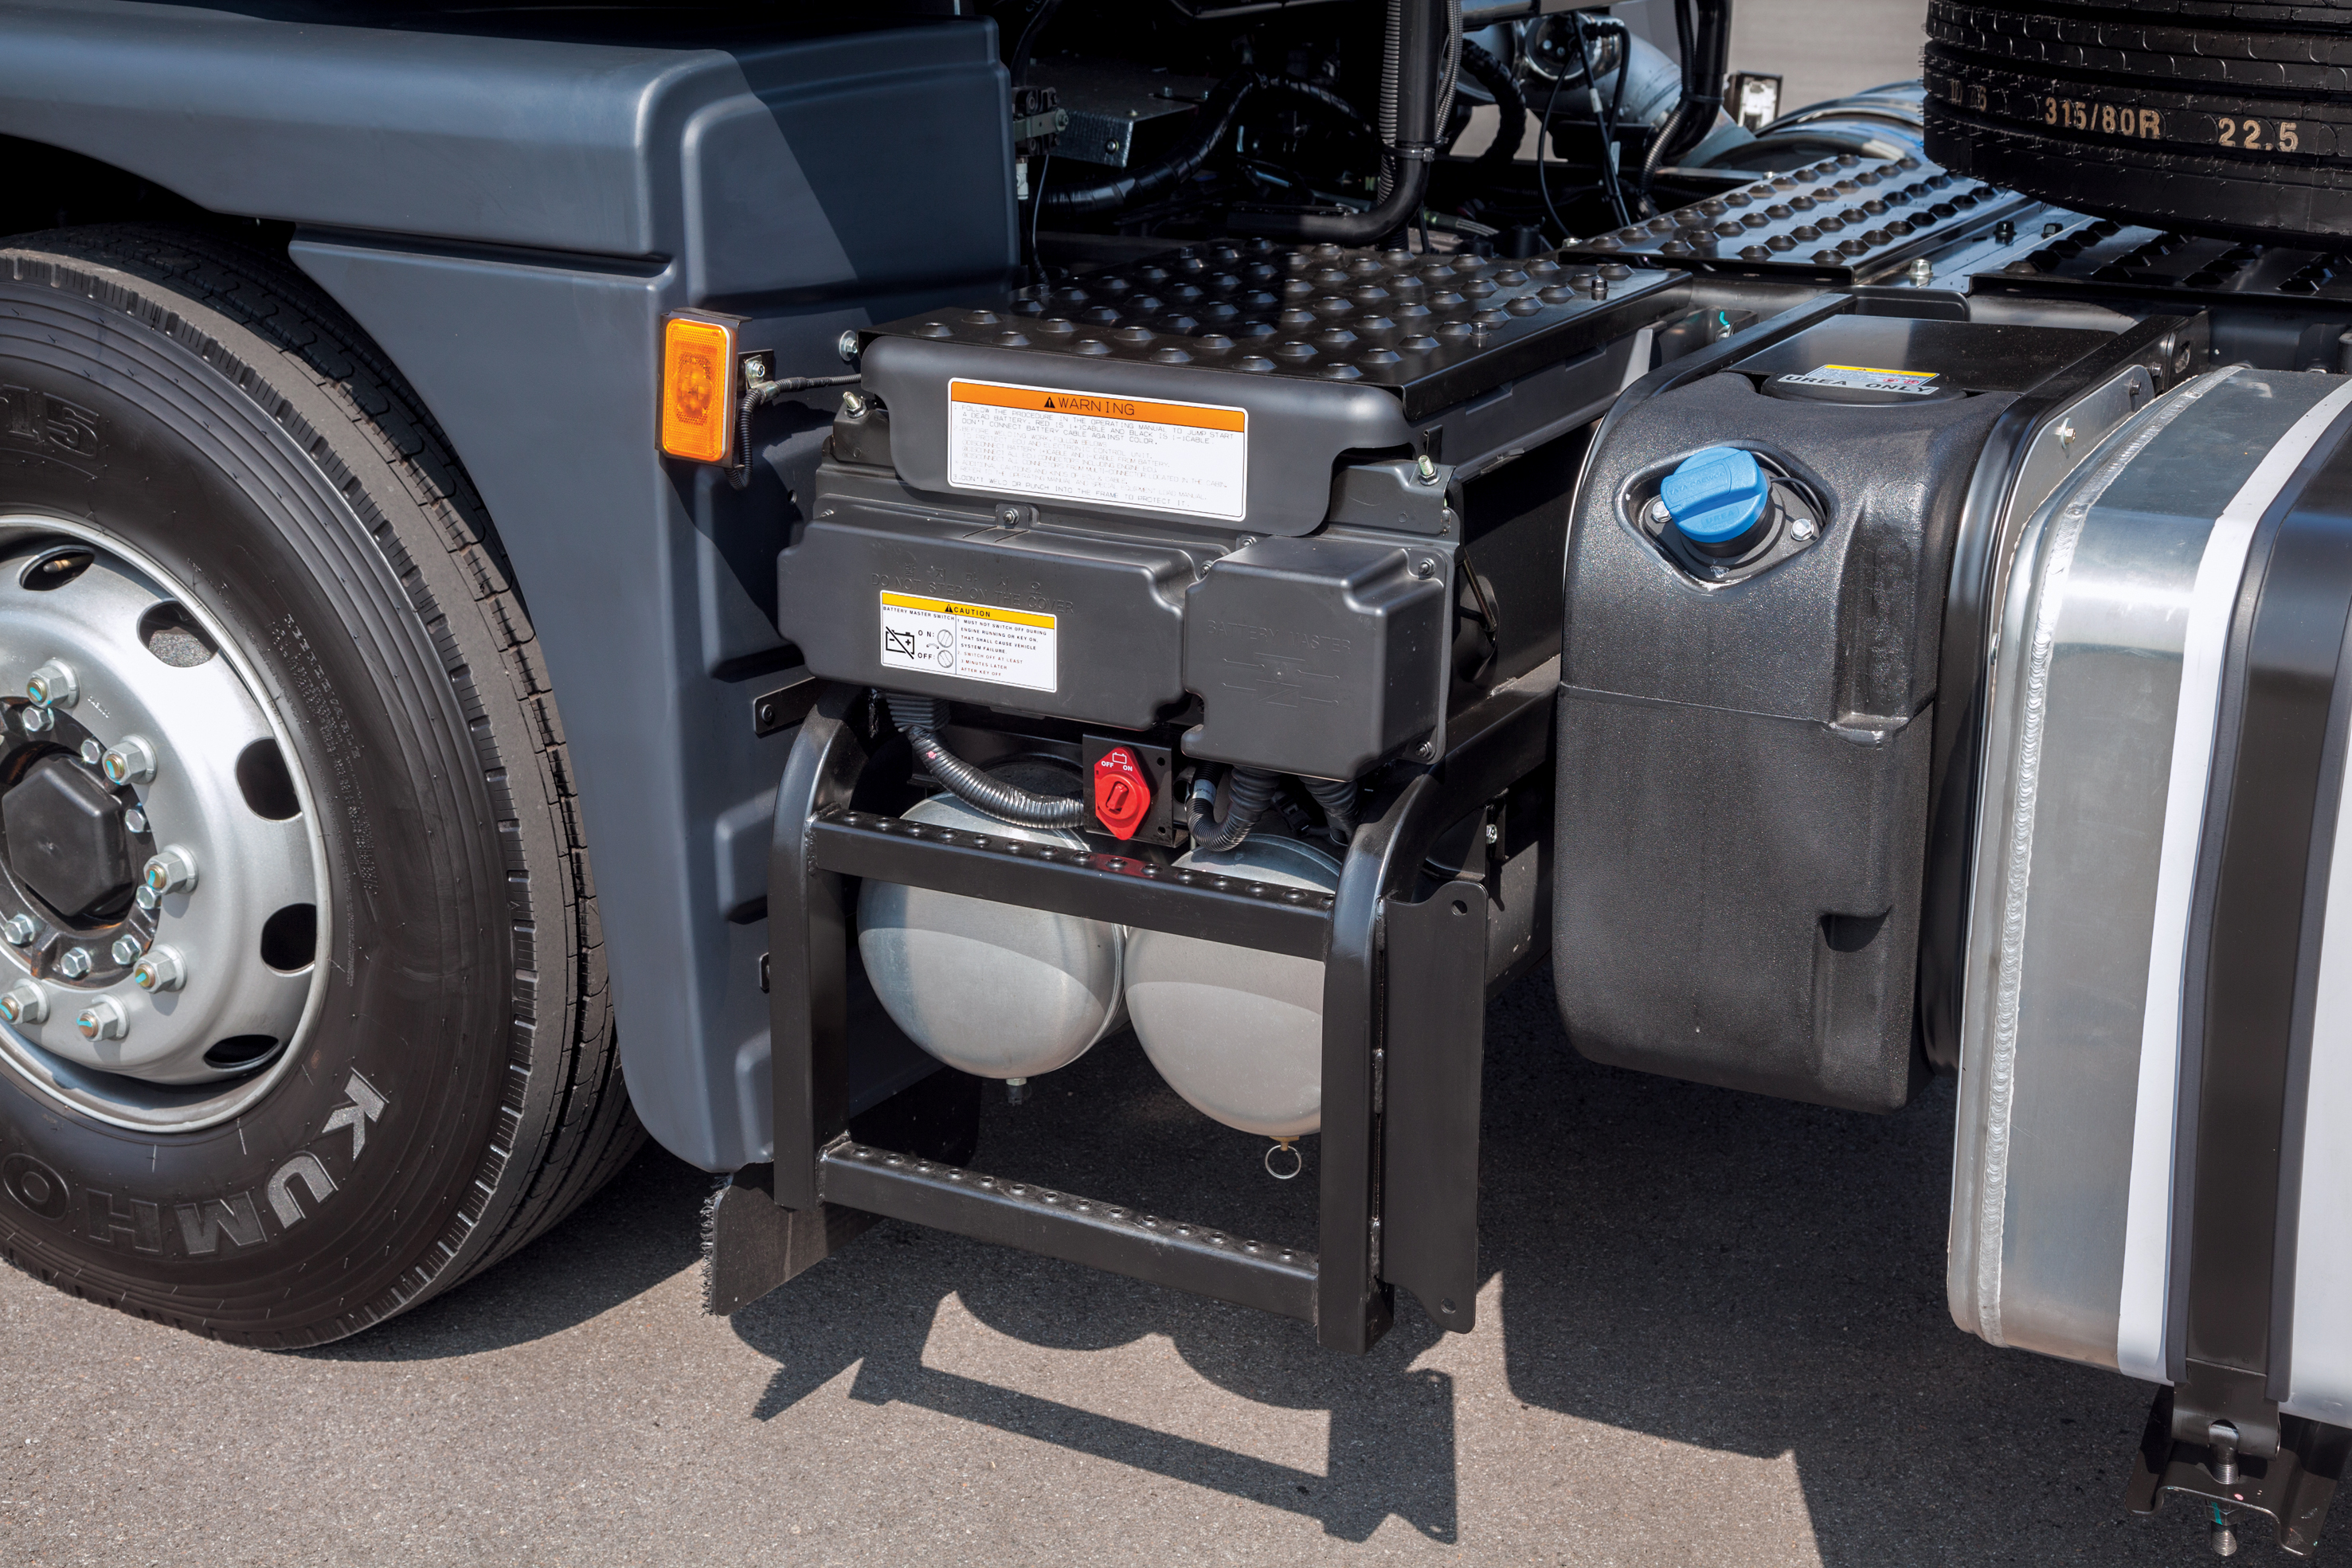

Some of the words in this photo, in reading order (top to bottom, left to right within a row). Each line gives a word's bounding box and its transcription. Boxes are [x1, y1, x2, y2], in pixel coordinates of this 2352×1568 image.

[2045, 96, 2161, 140] 315/80R
[2217, 117, 2300, 154] 22.5
[1786, 376, 1847, 385] UREA
[1865, 383, 1931, 393] ONLY
[1059, 397, 1135, 416] WARNING
[871, 573, 890, 587] DO
[895, 577, 921, 591] NOT
[928, 581, 963, 597] STEP
[969, 587, 988, 602] ON
[994, 590, 1021, 607] THE
[1027, 596, 1074, 615] COVER
[882, 605, 907, 614] BATTERY
[954, 606, 992, 618] CAUTION
[981, 629, 1005, 638] RUNNING
[1207, 620, 1279, 643] BATTERY
[1289, 631, 1352, 655] MASTER
[961, 642, 980, 651] SYSTEM
[1014, 642, 1035, 651] VEHICLE
[2, 1067, 389, 1256] KUMHO
